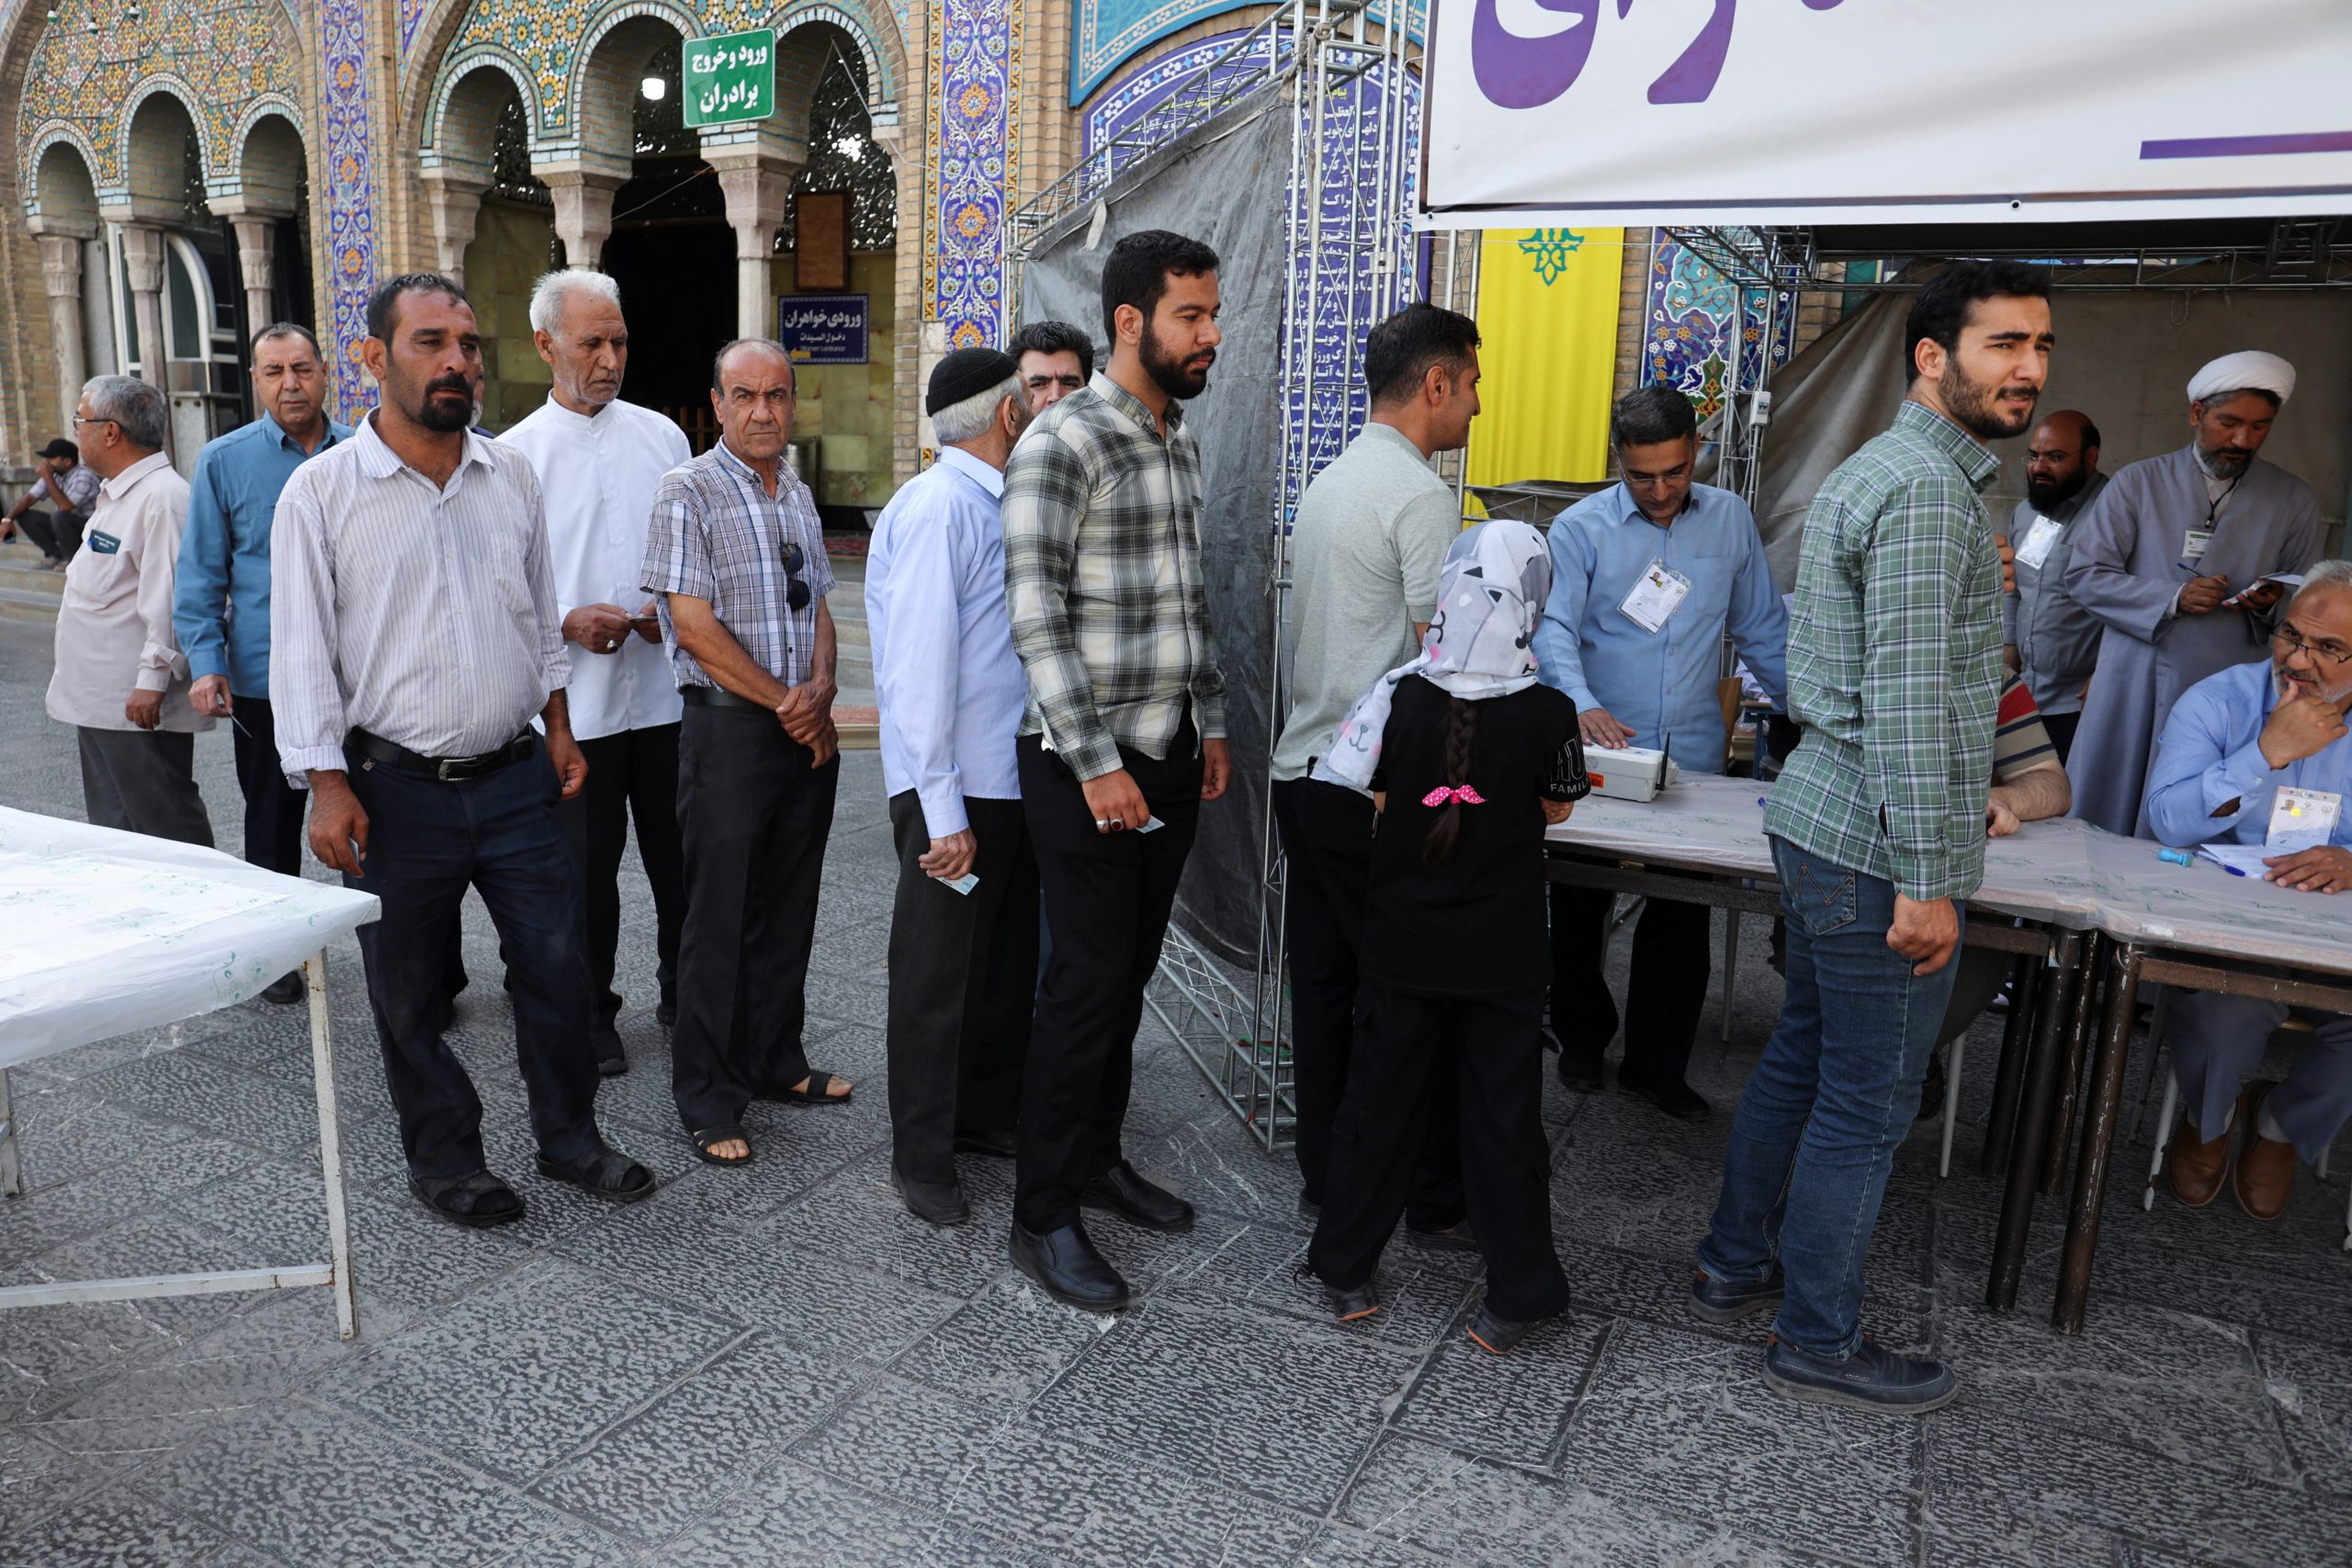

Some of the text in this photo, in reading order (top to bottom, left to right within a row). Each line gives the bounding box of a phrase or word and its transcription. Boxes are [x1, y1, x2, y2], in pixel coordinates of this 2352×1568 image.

[692, 44, 767, 73] ورود و خروج
[700, 79, 759, 113] برادران
[785, 309, 862, 329] ورودی خواهران
